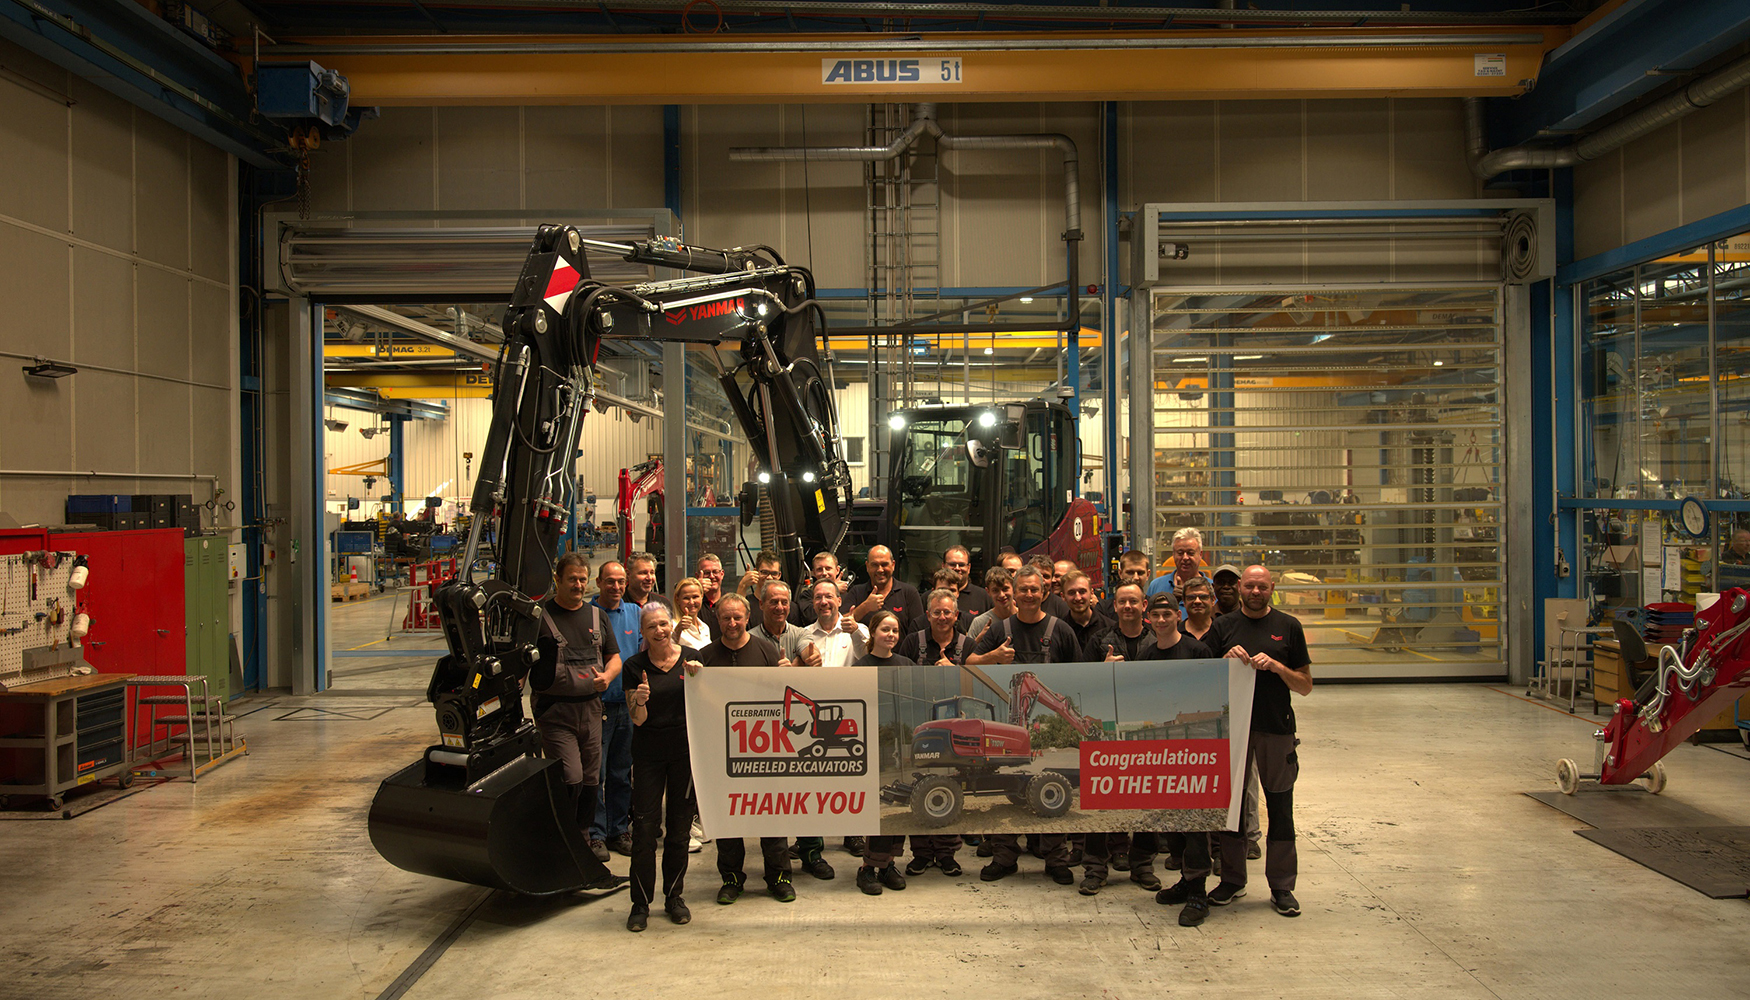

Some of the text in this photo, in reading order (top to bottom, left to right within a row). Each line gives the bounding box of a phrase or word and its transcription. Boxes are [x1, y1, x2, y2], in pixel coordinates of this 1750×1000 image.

[825, 60, 920, 82] ABUS
[689, 298, 745, 321] YANMAR
[1075, 522, 1081, 537] 20
[731, 709, 781, 717] CELEBRATING
[731, 720, 796, 753] 16K
[914, 752, 940, 760] YANMAR
[1089, 748, 1218, 770] Congratulations
[732, 760, 864, 774] WHEELED EXCAVATORS
[1090, 776, 1114, 795] TO
[1118, 776, 1152, 794] THE
[1156, 775, 1208, 794] TEAM
[728, 792, 866, 816] THANK YOU
